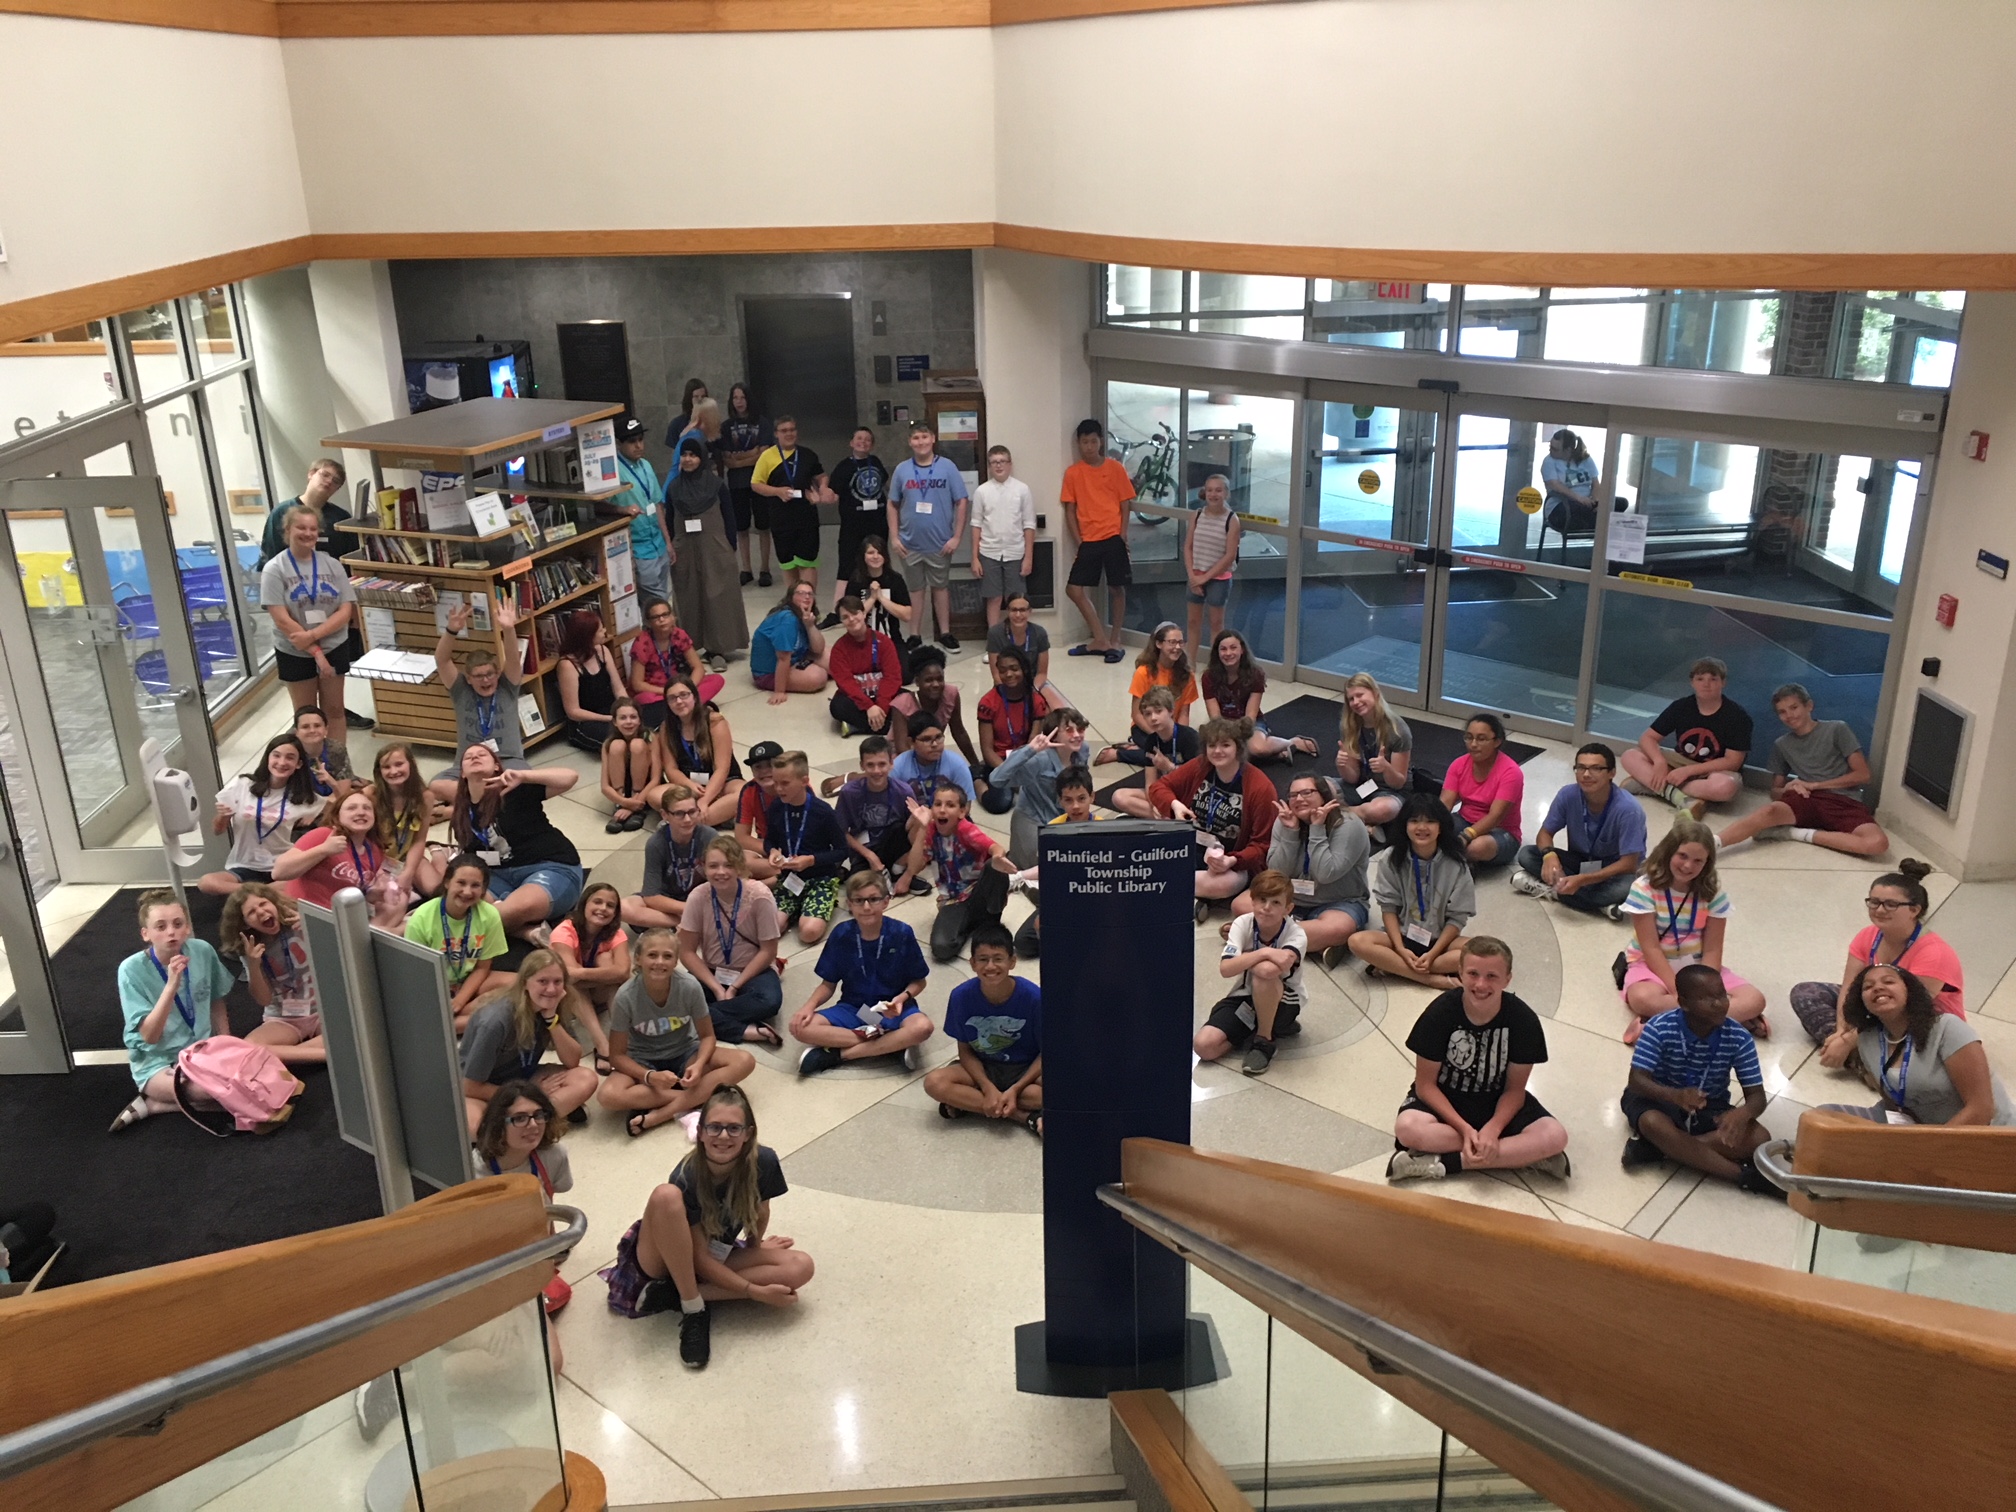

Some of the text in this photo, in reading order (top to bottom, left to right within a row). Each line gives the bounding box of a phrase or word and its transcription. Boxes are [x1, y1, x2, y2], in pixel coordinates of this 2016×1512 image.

[905, 479, 947, 489] AMERICA
[1047, 850, 1112, 863] Plainfield
[1131, 845, 1188, 863] Guilford
[1084, 865, 1152, 879] Township
[1069, 880, 1167, 894] Public Library
